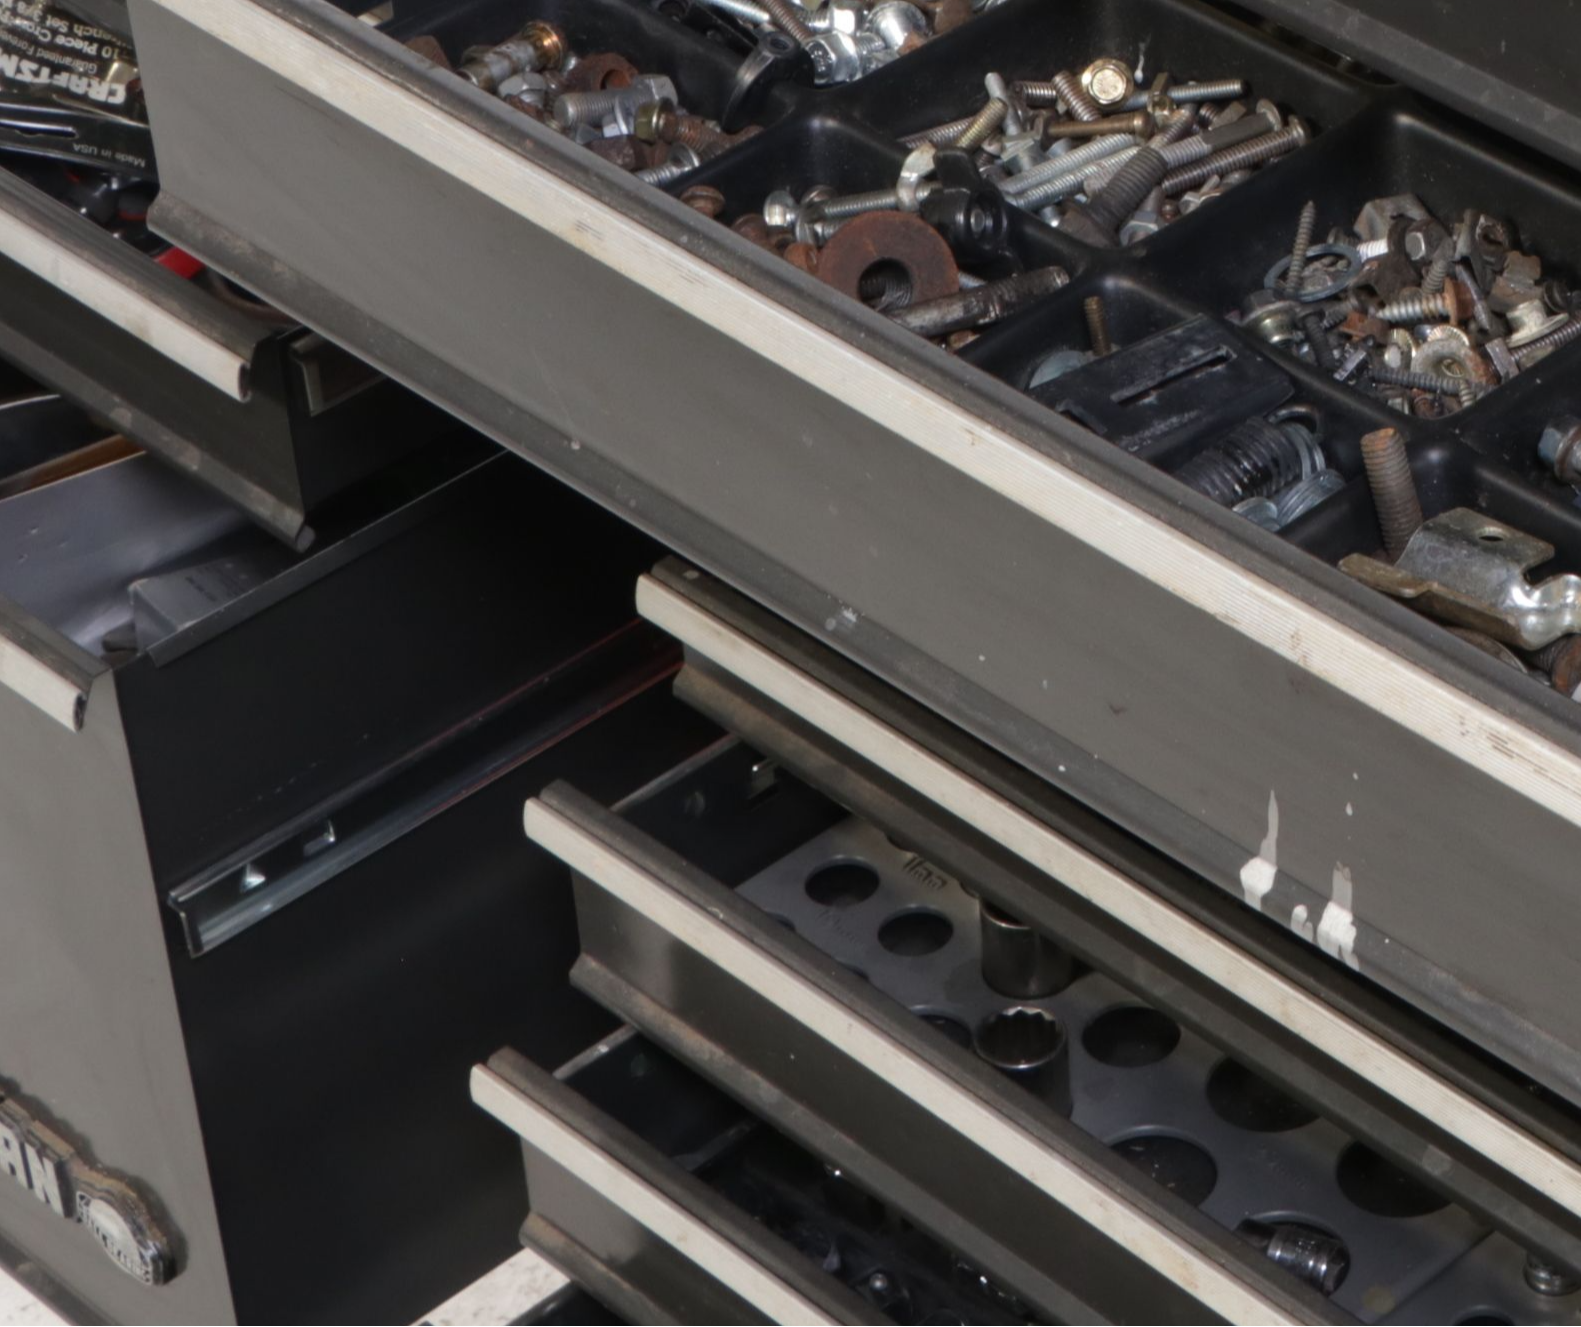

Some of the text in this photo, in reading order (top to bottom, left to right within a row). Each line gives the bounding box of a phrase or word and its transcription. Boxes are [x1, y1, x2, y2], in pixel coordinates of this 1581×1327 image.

[50, 15, 70, 34] Set
[53, 34, 98, 57] Piece
[102, 45, 121, 60] 10
[34, 49, 98, 75] Guaranteed
[72, 142, 146, 168] Made in USA
